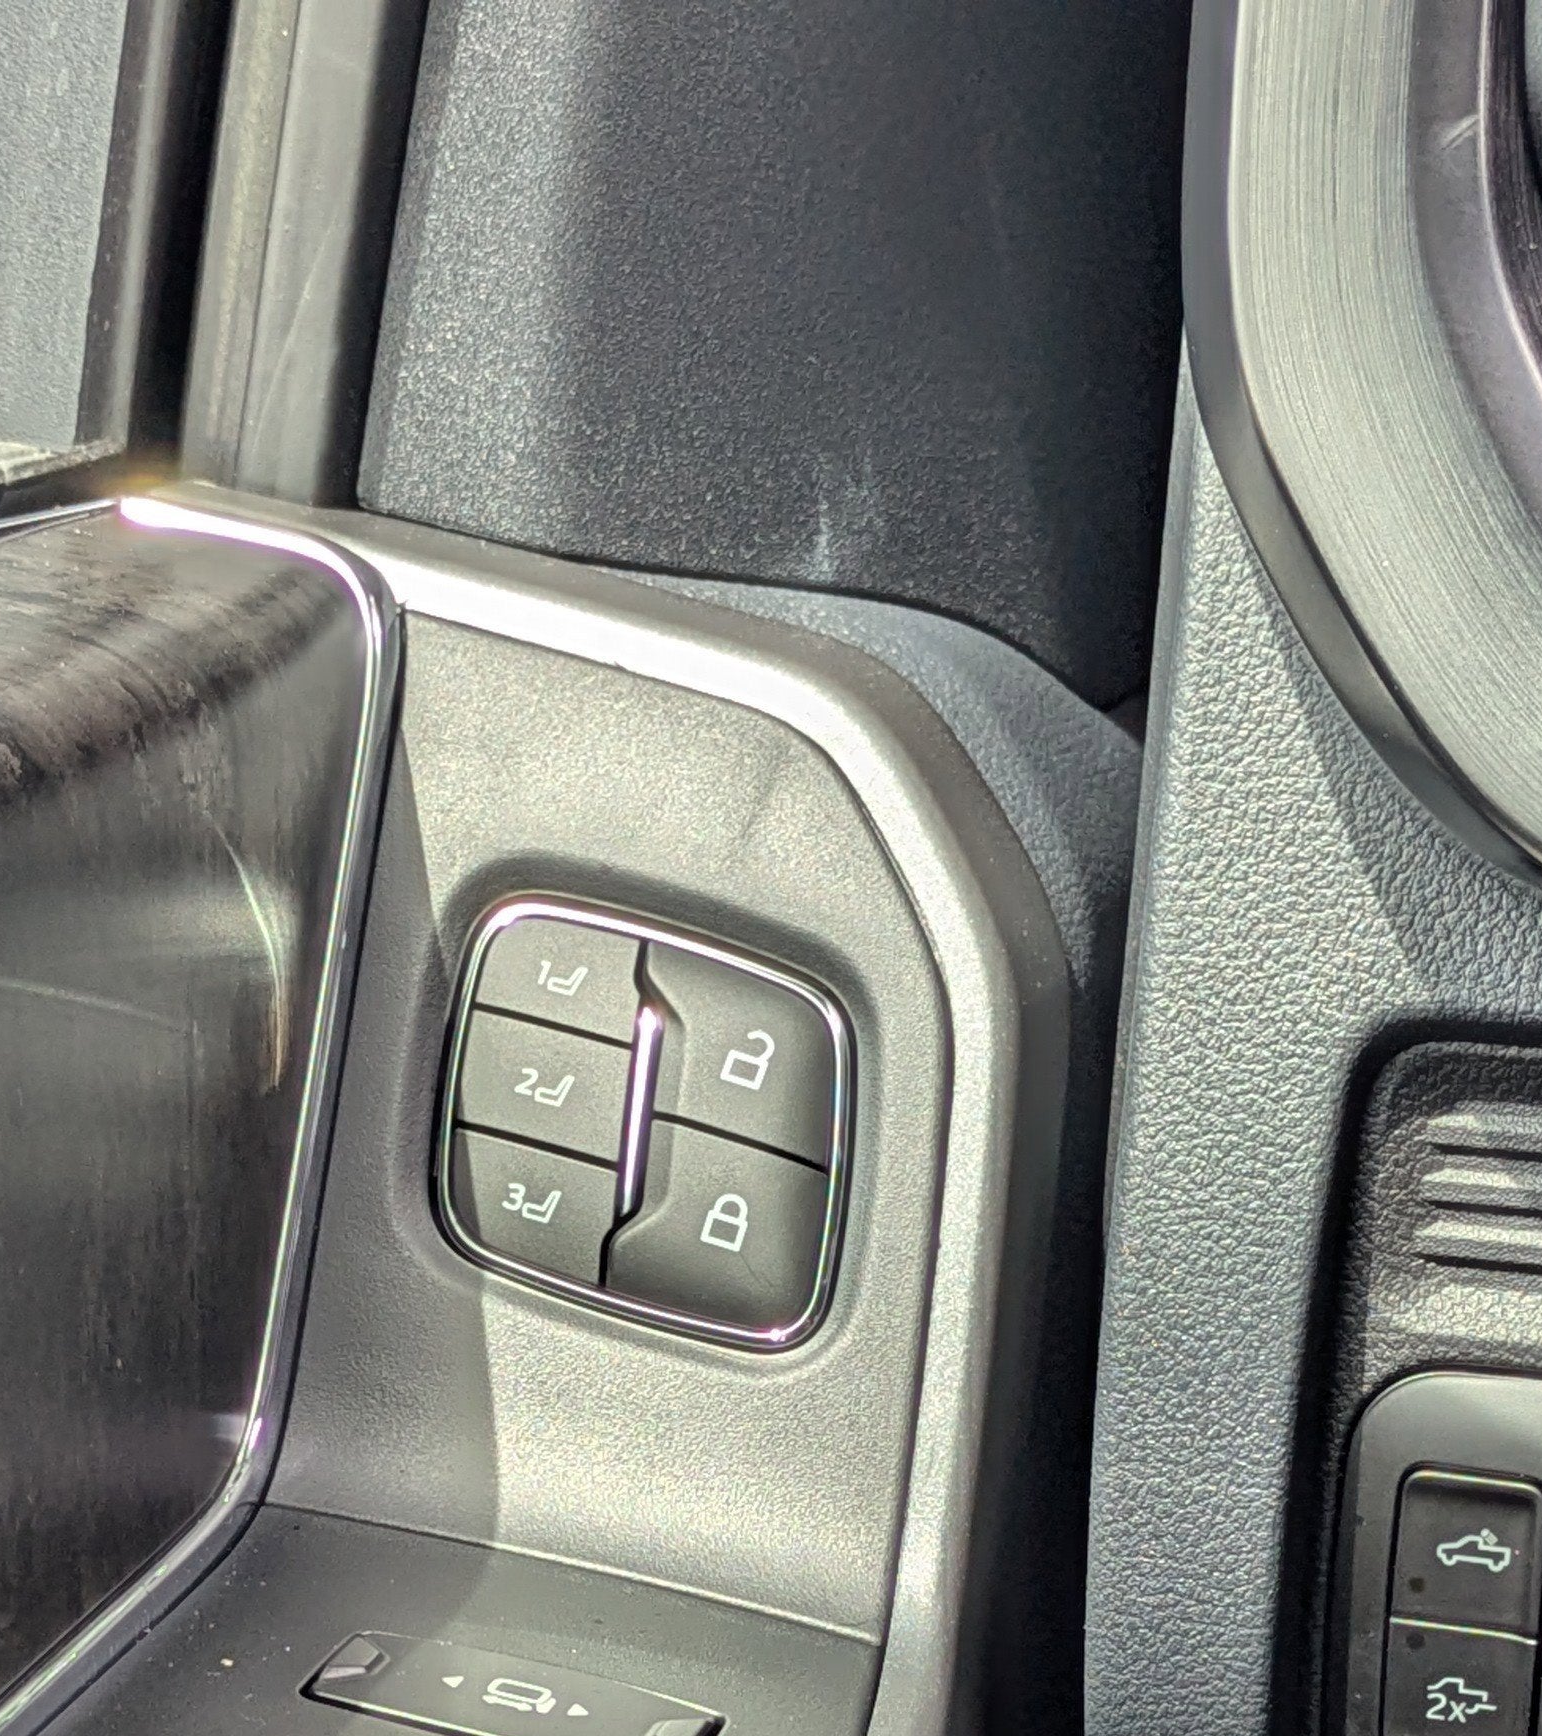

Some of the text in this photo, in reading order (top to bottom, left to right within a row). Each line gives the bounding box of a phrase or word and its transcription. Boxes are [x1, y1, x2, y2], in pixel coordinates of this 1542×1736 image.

[537, 960, 552, 985] 1
[514, 1068, 539, 1096] 2
[501, 1183, 526, 1211] 3
